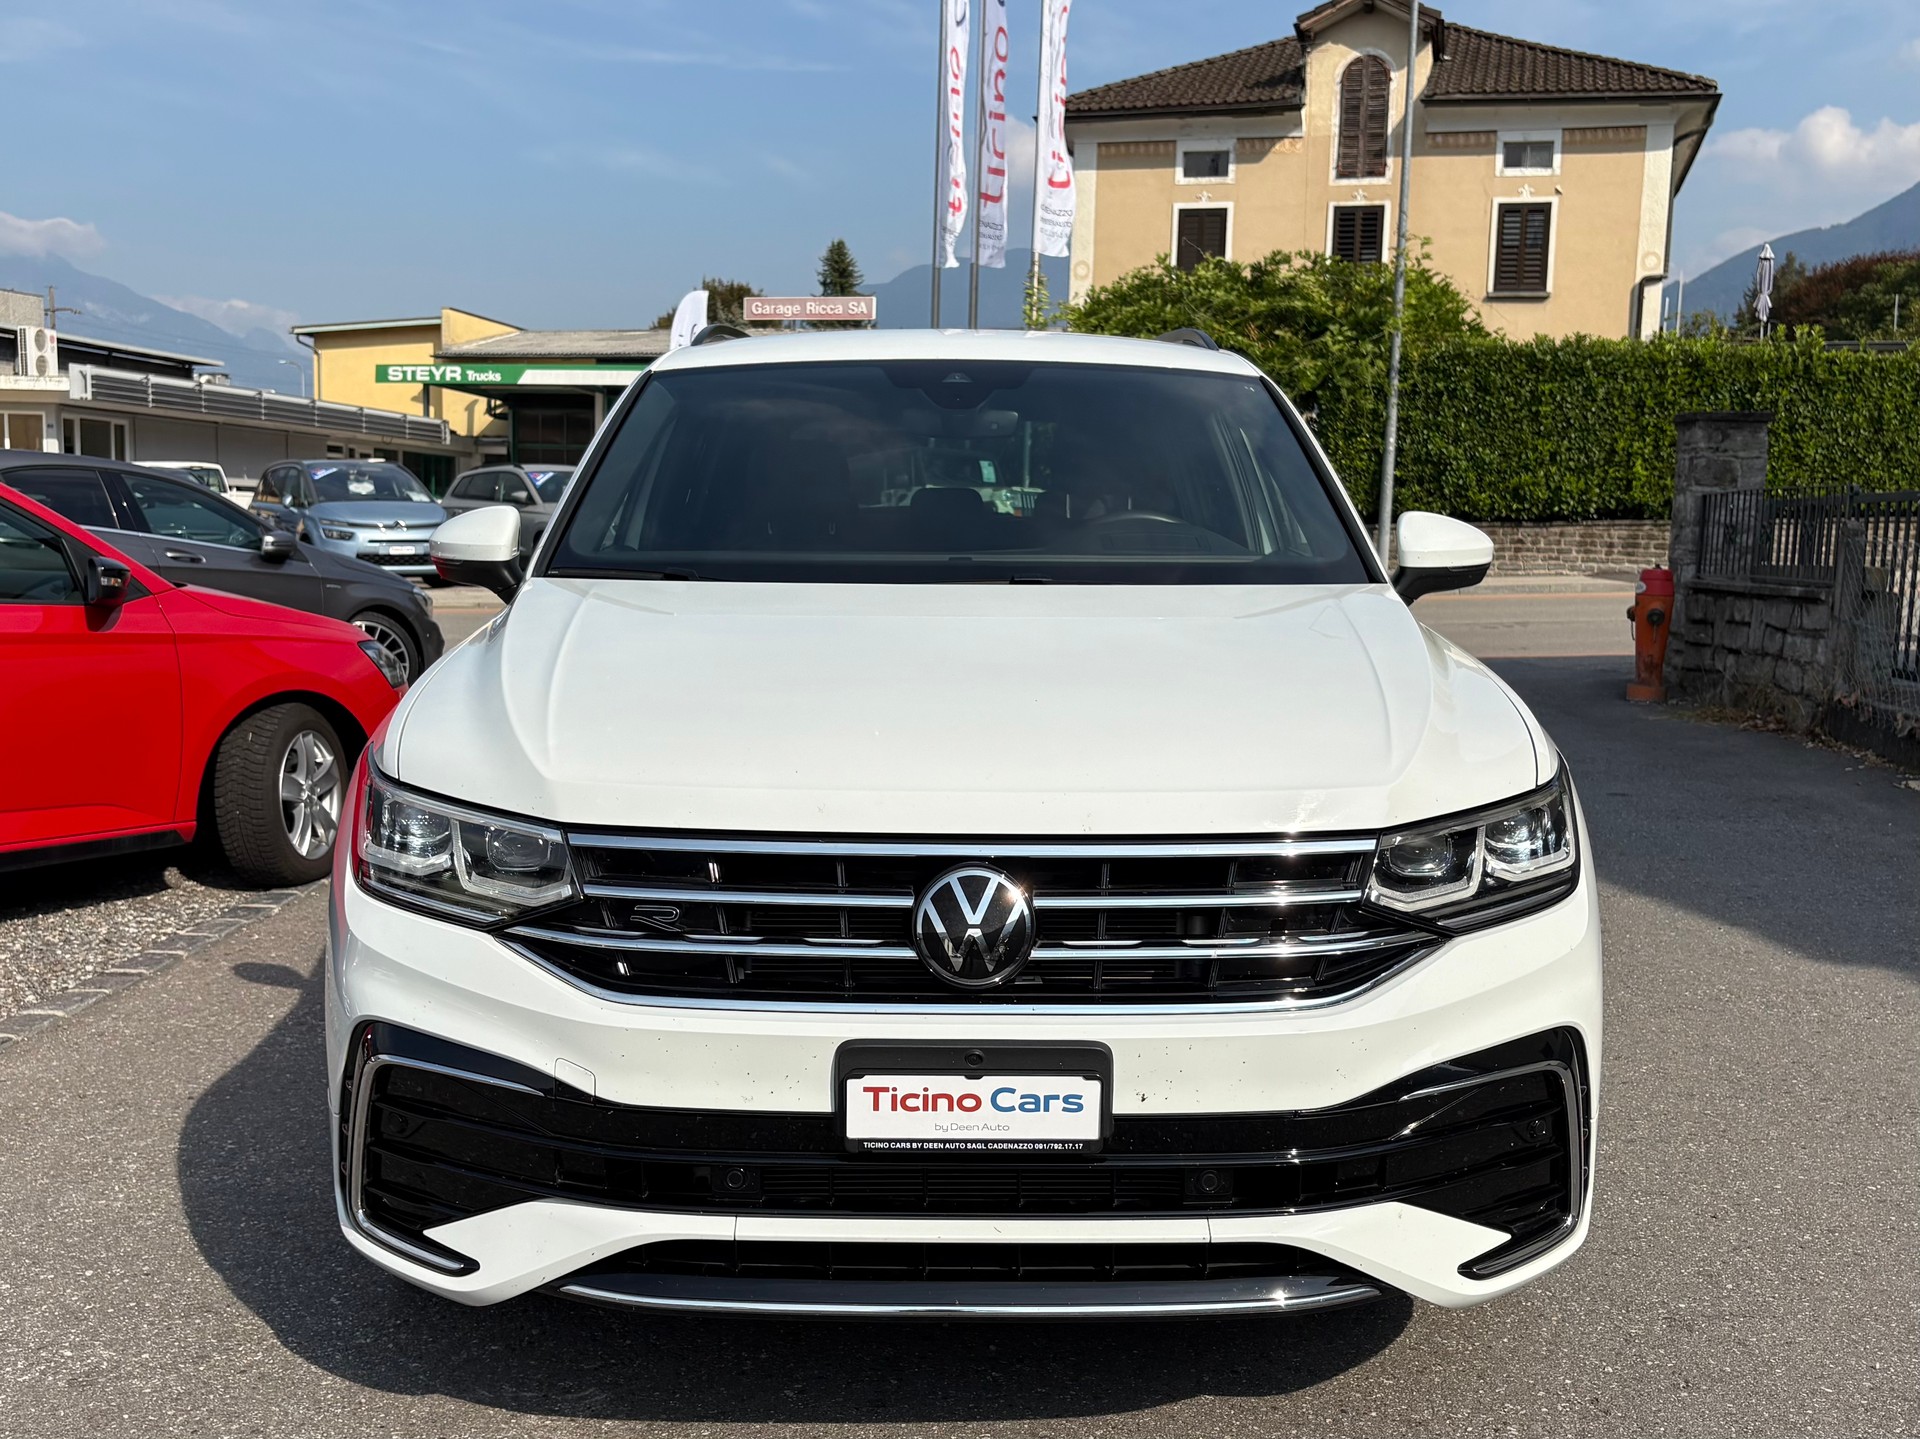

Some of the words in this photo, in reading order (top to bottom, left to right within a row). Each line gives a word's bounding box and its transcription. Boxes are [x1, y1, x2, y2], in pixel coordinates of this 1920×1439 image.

[751, 301, 801, 317] Garage
[806, 301, 843, 315] Ricca
[848, 301, 868, 315] SA
[387, 365, 462, 382] STEYR
[466, 370, 502, 382] Trucks
[862, 1086, 982, 1113] Ticino
[990, 1086, 1084, 1113] Cars
[934, 1122, 949, 1133] by
[950, 1122, 980, 1132] Deen
[981, 1122, 1011, 1132] Auto
[863, 1141, 889, 1149] TICINO
[890, 1141, 911, 1149] CARS
[945, 1142, 966, 1150] AUTO
[966, 1142, 987, 1150] SAGL
[987, 1142, 1034, 1150] CADENAZZO
